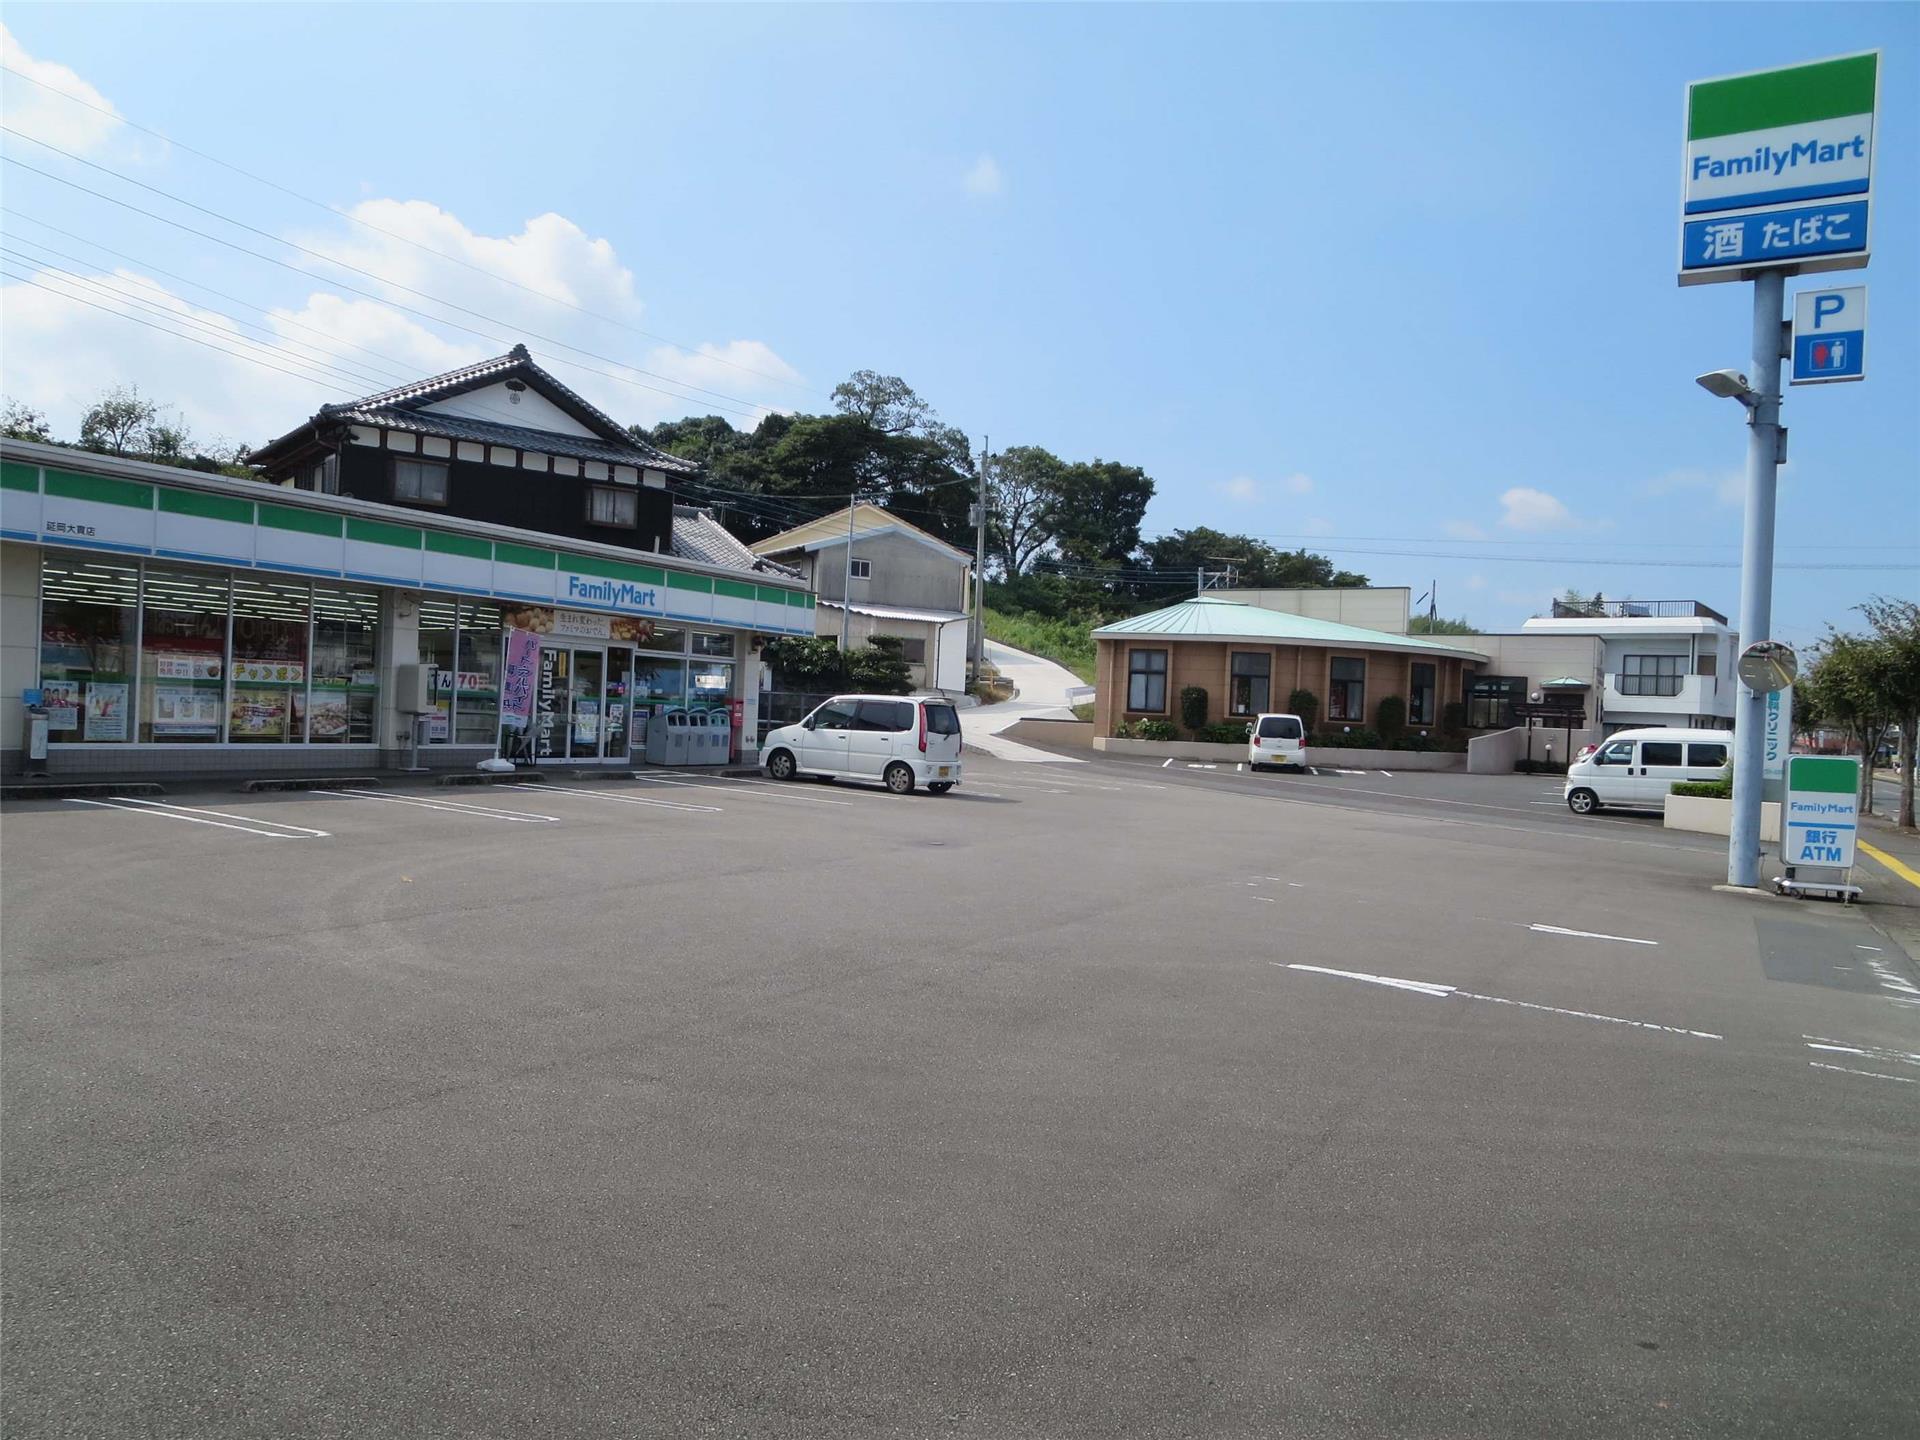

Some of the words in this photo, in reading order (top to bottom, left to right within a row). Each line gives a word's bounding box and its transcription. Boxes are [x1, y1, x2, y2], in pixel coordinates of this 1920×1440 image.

[1693, 135, 1864, 180] FamilyMart
[1703, 222, 1744, 260] 酒
[1762, 213, 1850, 248] たばこ
[1814, 295, 1845, 329] P
[569, 576, 655, 607] FamilyMart
[539, 650, 557, 756] FamilyMart
[1791, 802, 1854, 814] FamilyMart
[1805, 830, 1837, 845] 銀行
[1801, 847, 1842, 862] ATM
